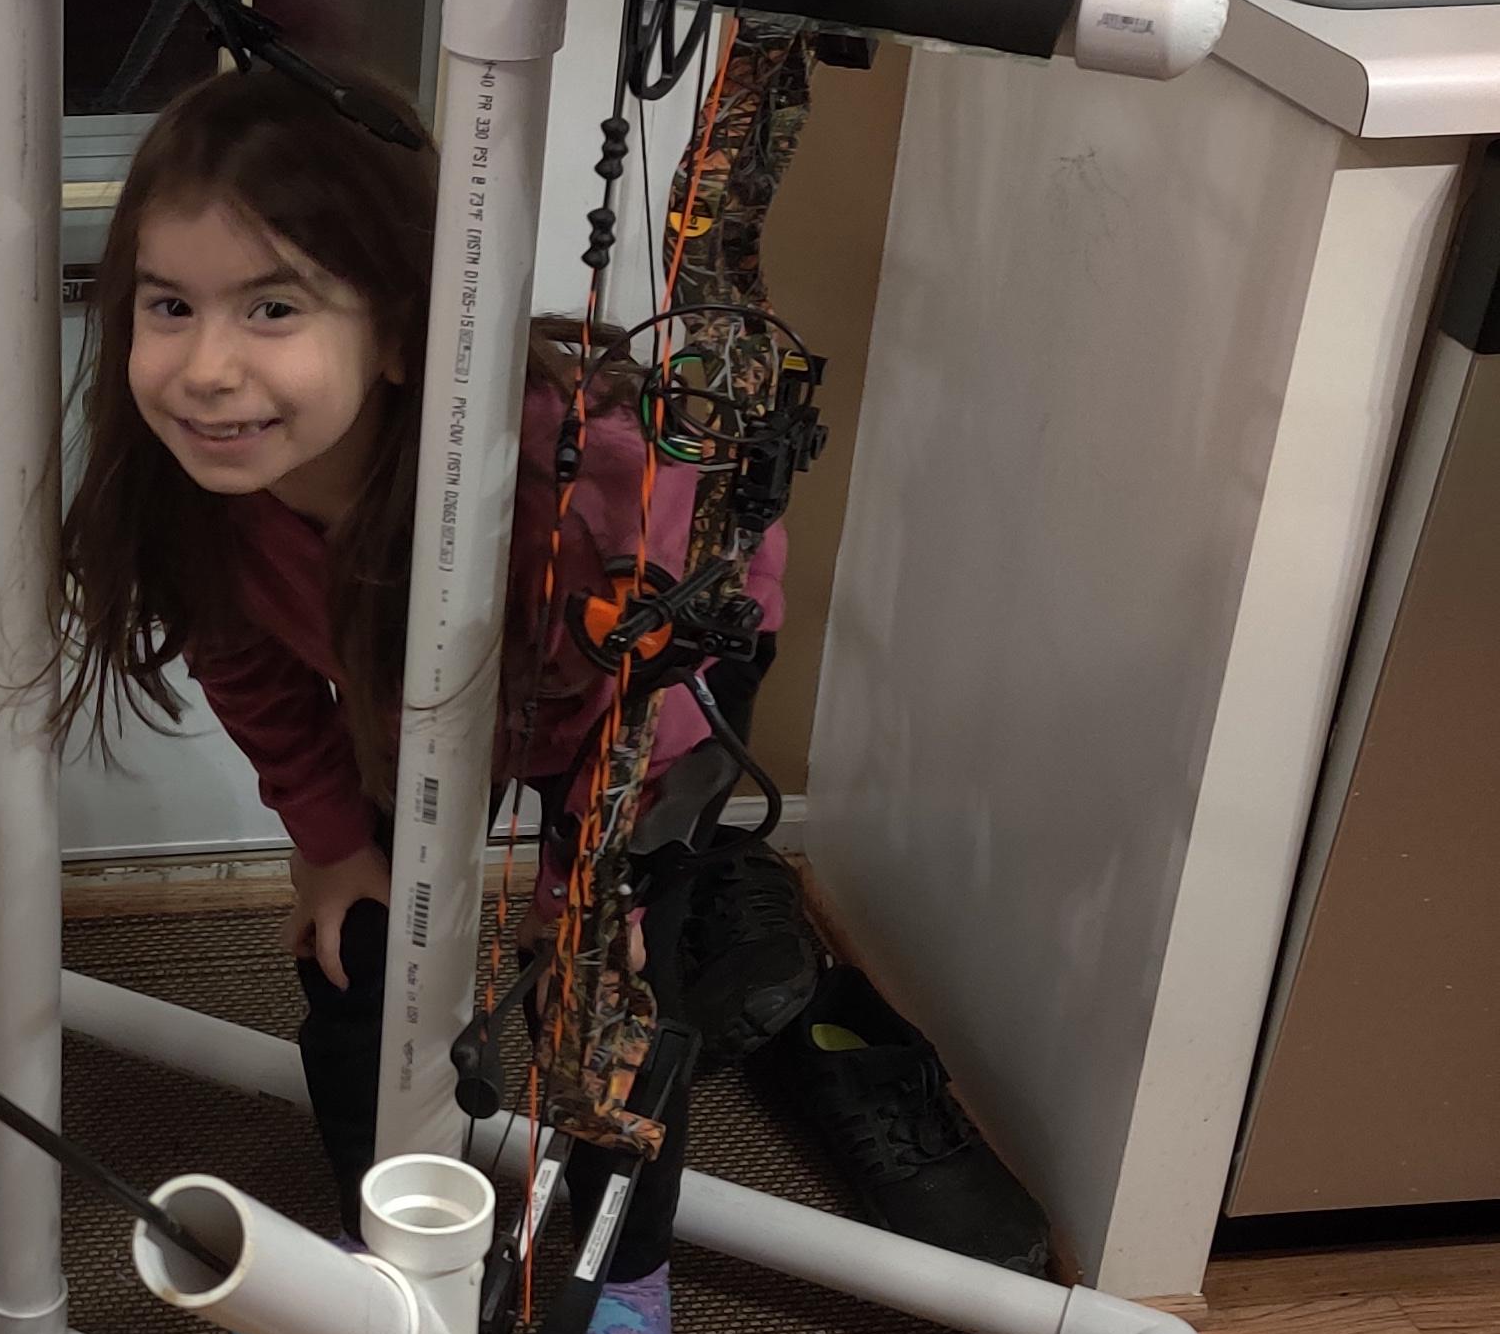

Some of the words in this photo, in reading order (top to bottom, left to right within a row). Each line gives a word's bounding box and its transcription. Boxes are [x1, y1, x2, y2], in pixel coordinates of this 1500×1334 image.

[477, 95, 493, 110] PR
[475, 117, 491, 139] 330
[472, 147, 488, 167] PSI
